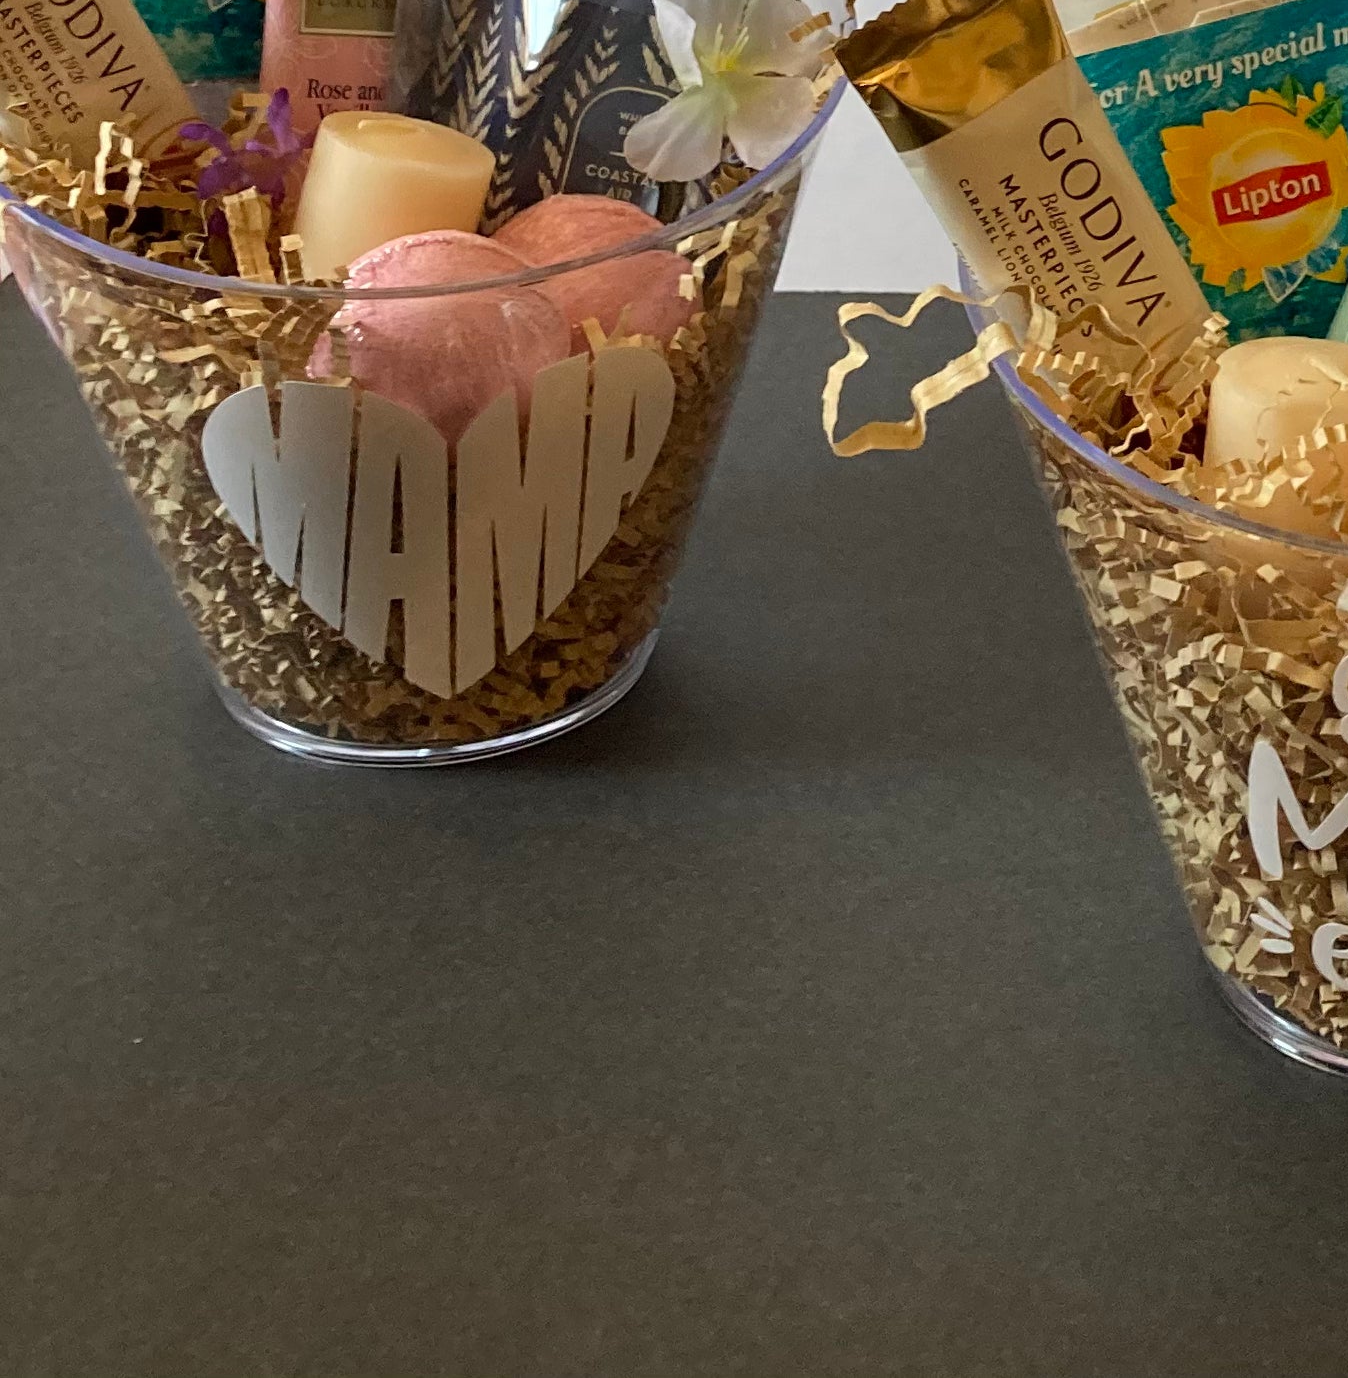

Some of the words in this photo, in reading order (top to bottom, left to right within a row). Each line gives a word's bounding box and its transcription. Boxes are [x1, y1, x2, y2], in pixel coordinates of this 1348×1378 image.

[25, 0, 67, 55] Belgium
[57, 56, 88, 85] 1926
[307, 78, 353, 101] Rose
[1091, 82, 1129, 110] or
[1134, 69, 1161, 100] A
[1164, 59, 1223, 89] very
[1231, 22, 1326, 75] special
[958, 178, 1001, 244] CARAMEL
[997, 247, 1023, 283] LION
[1039, 117, 1167, 327] GODIVA
[1039, 193, 1082, 257] Belgium
[1074, 258, 1106, 293] 1926
[1222, 171, 1322, 217] Lipton
[992, 206, 1018, 241] MILK
[1014, 245, 1062, 317] CHOCOLAT
[998, 173, 1094, 338] MASTERPIECS
